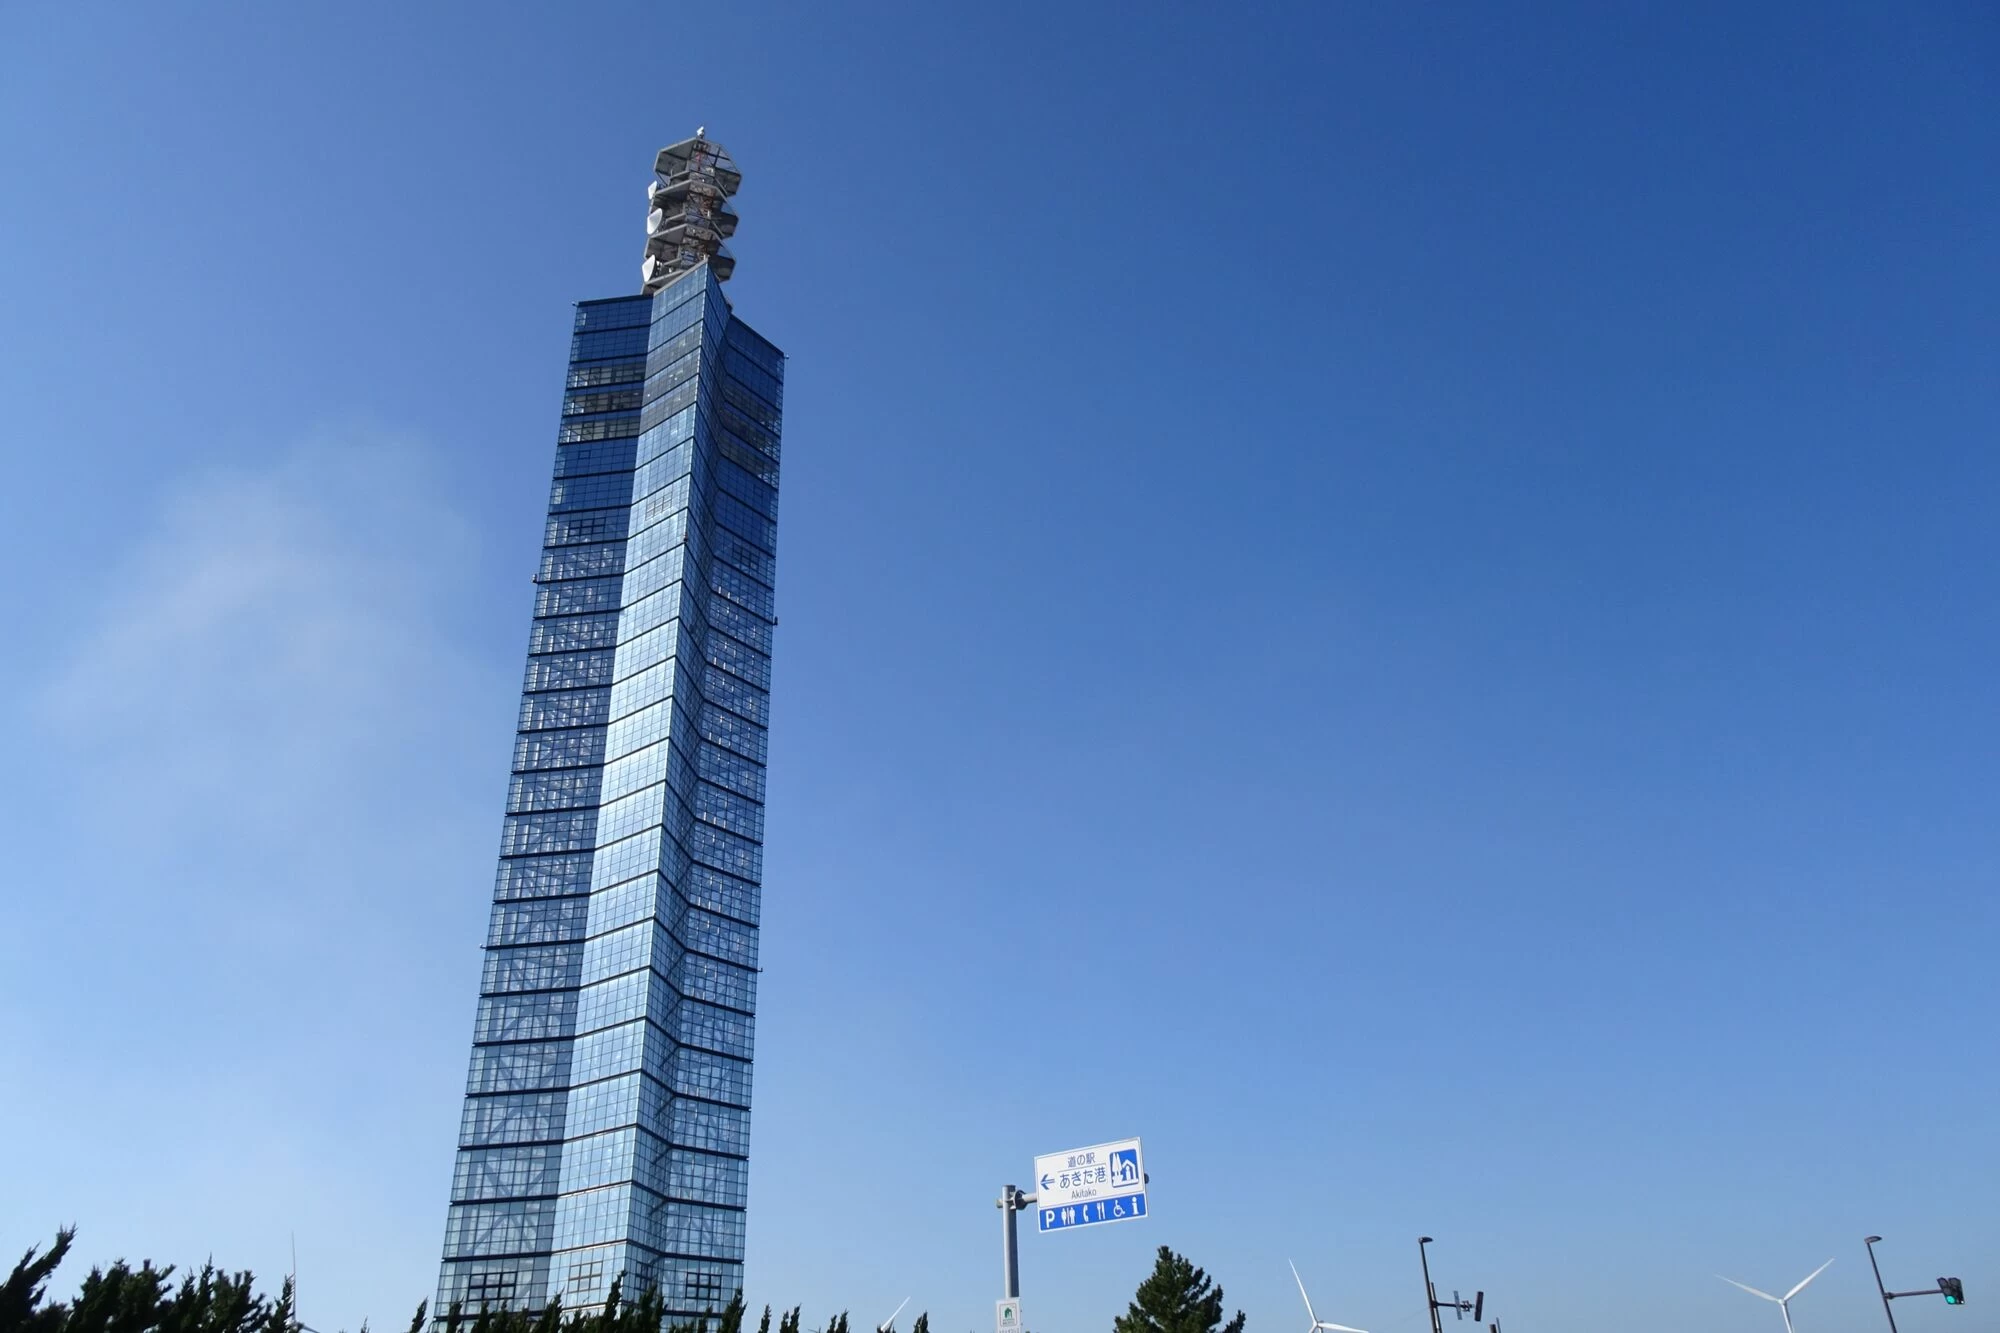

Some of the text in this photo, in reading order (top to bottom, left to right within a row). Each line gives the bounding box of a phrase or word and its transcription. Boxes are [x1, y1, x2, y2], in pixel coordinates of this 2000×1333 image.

[1067, 1152, 1096, 1168] 道の駅
[1059, 1166, 1107, 1189] あきた港
[1071, 1188, 1097, 1200] Akitako
[1045, 1210, 1056, 1228] P
